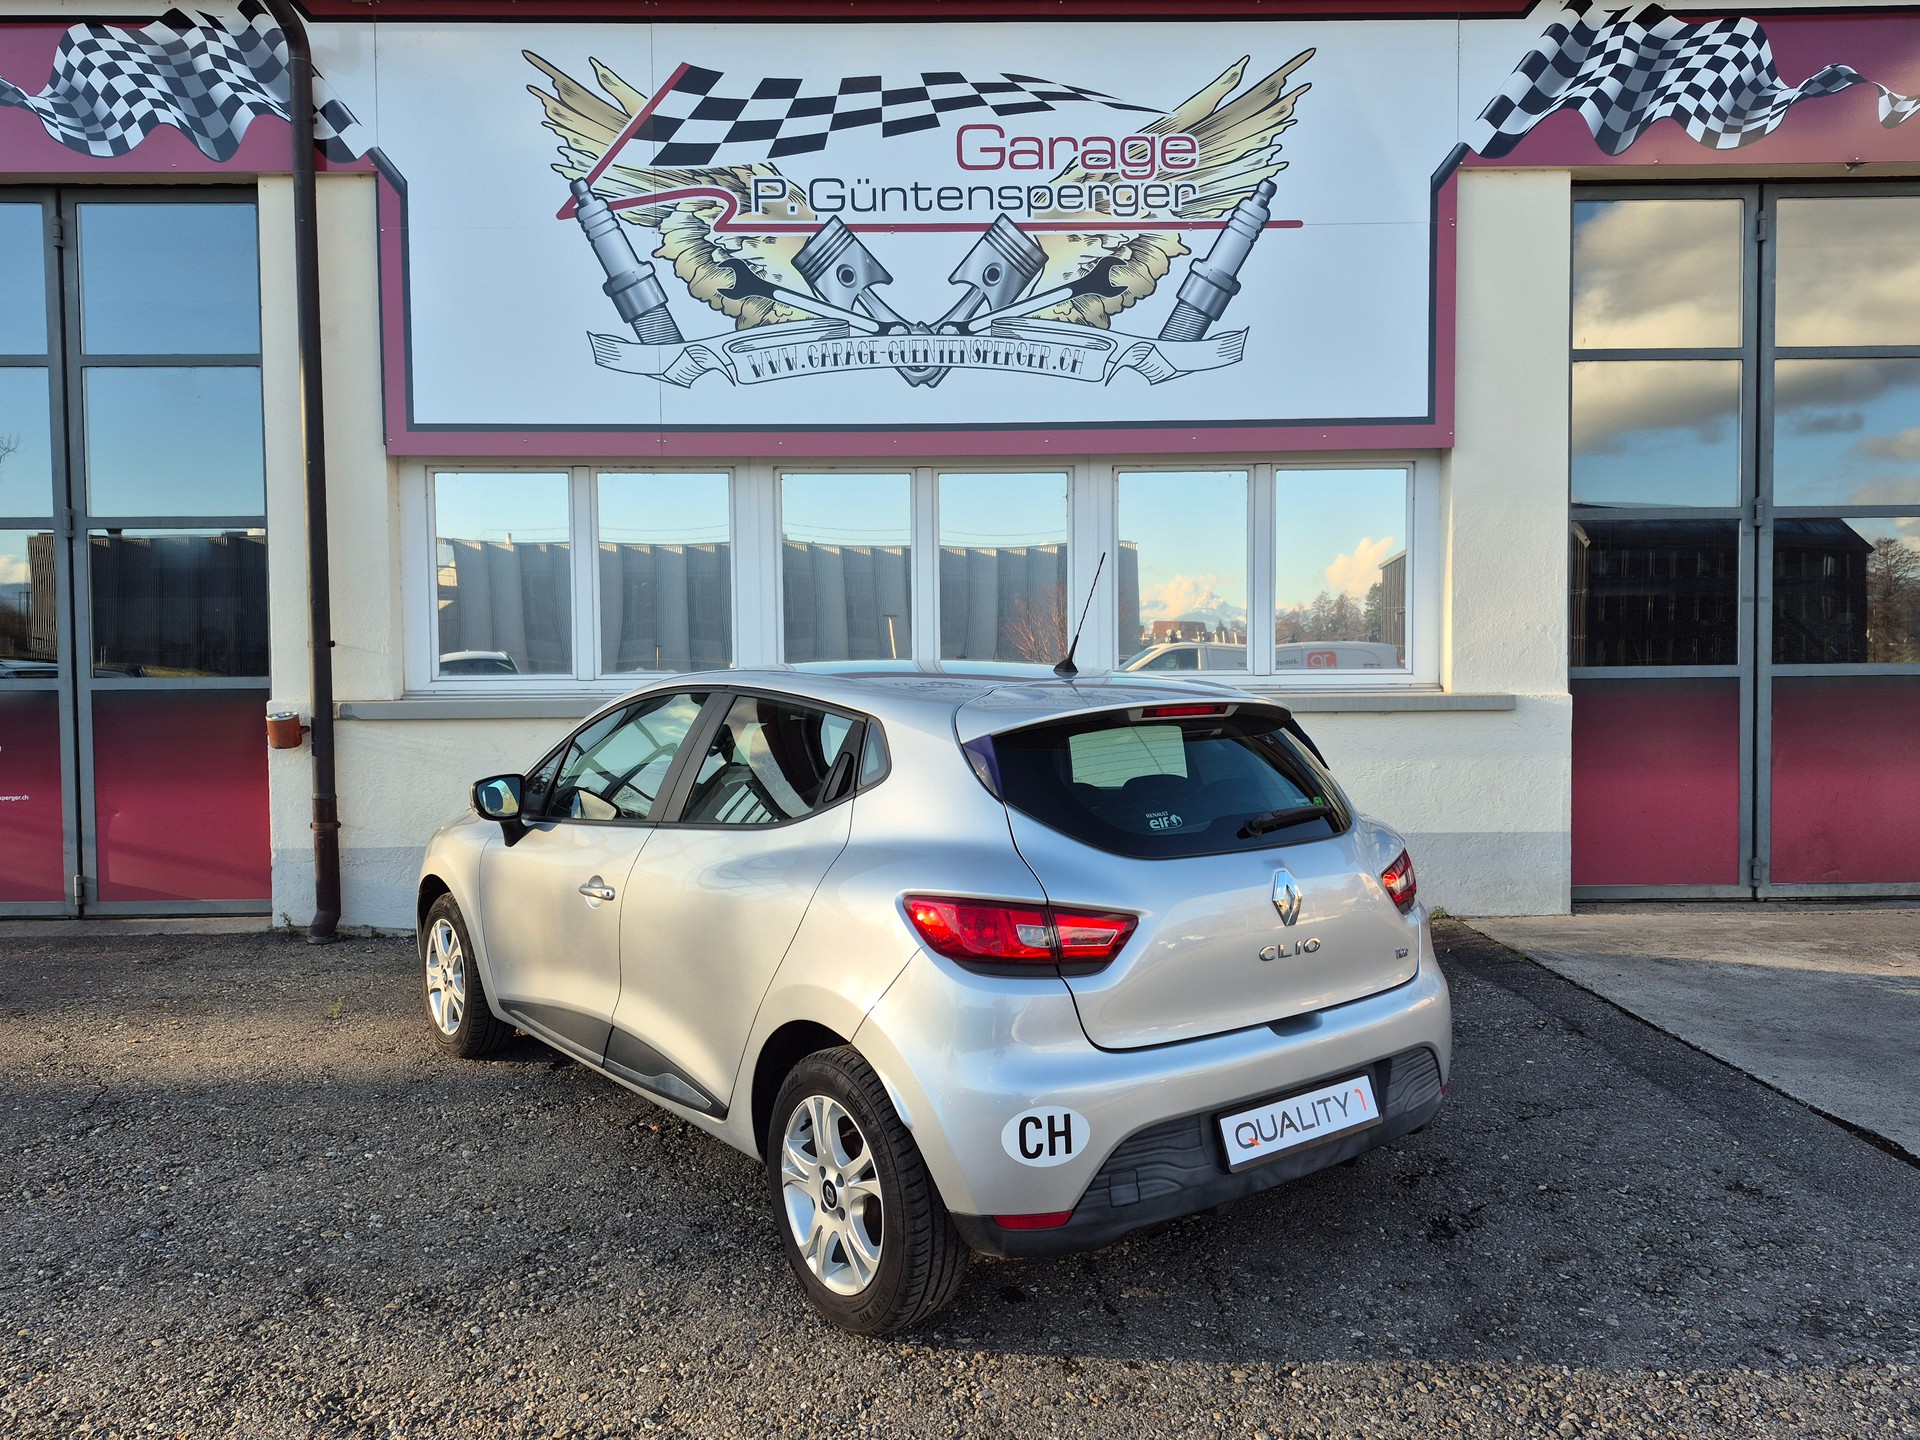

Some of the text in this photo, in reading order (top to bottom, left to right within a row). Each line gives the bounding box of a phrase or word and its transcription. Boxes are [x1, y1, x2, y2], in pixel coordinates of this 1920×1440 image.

[956, 123, 1197, 180] Garage
[746, 338, 1086, 378] WWW.GARAGE-GUENTENSPERGER.CH
[1149, 817, 1170, 829] elf
[1258, 937, 1321, 961] CLIO
[1018, 1113, 1073, 1159] CH
